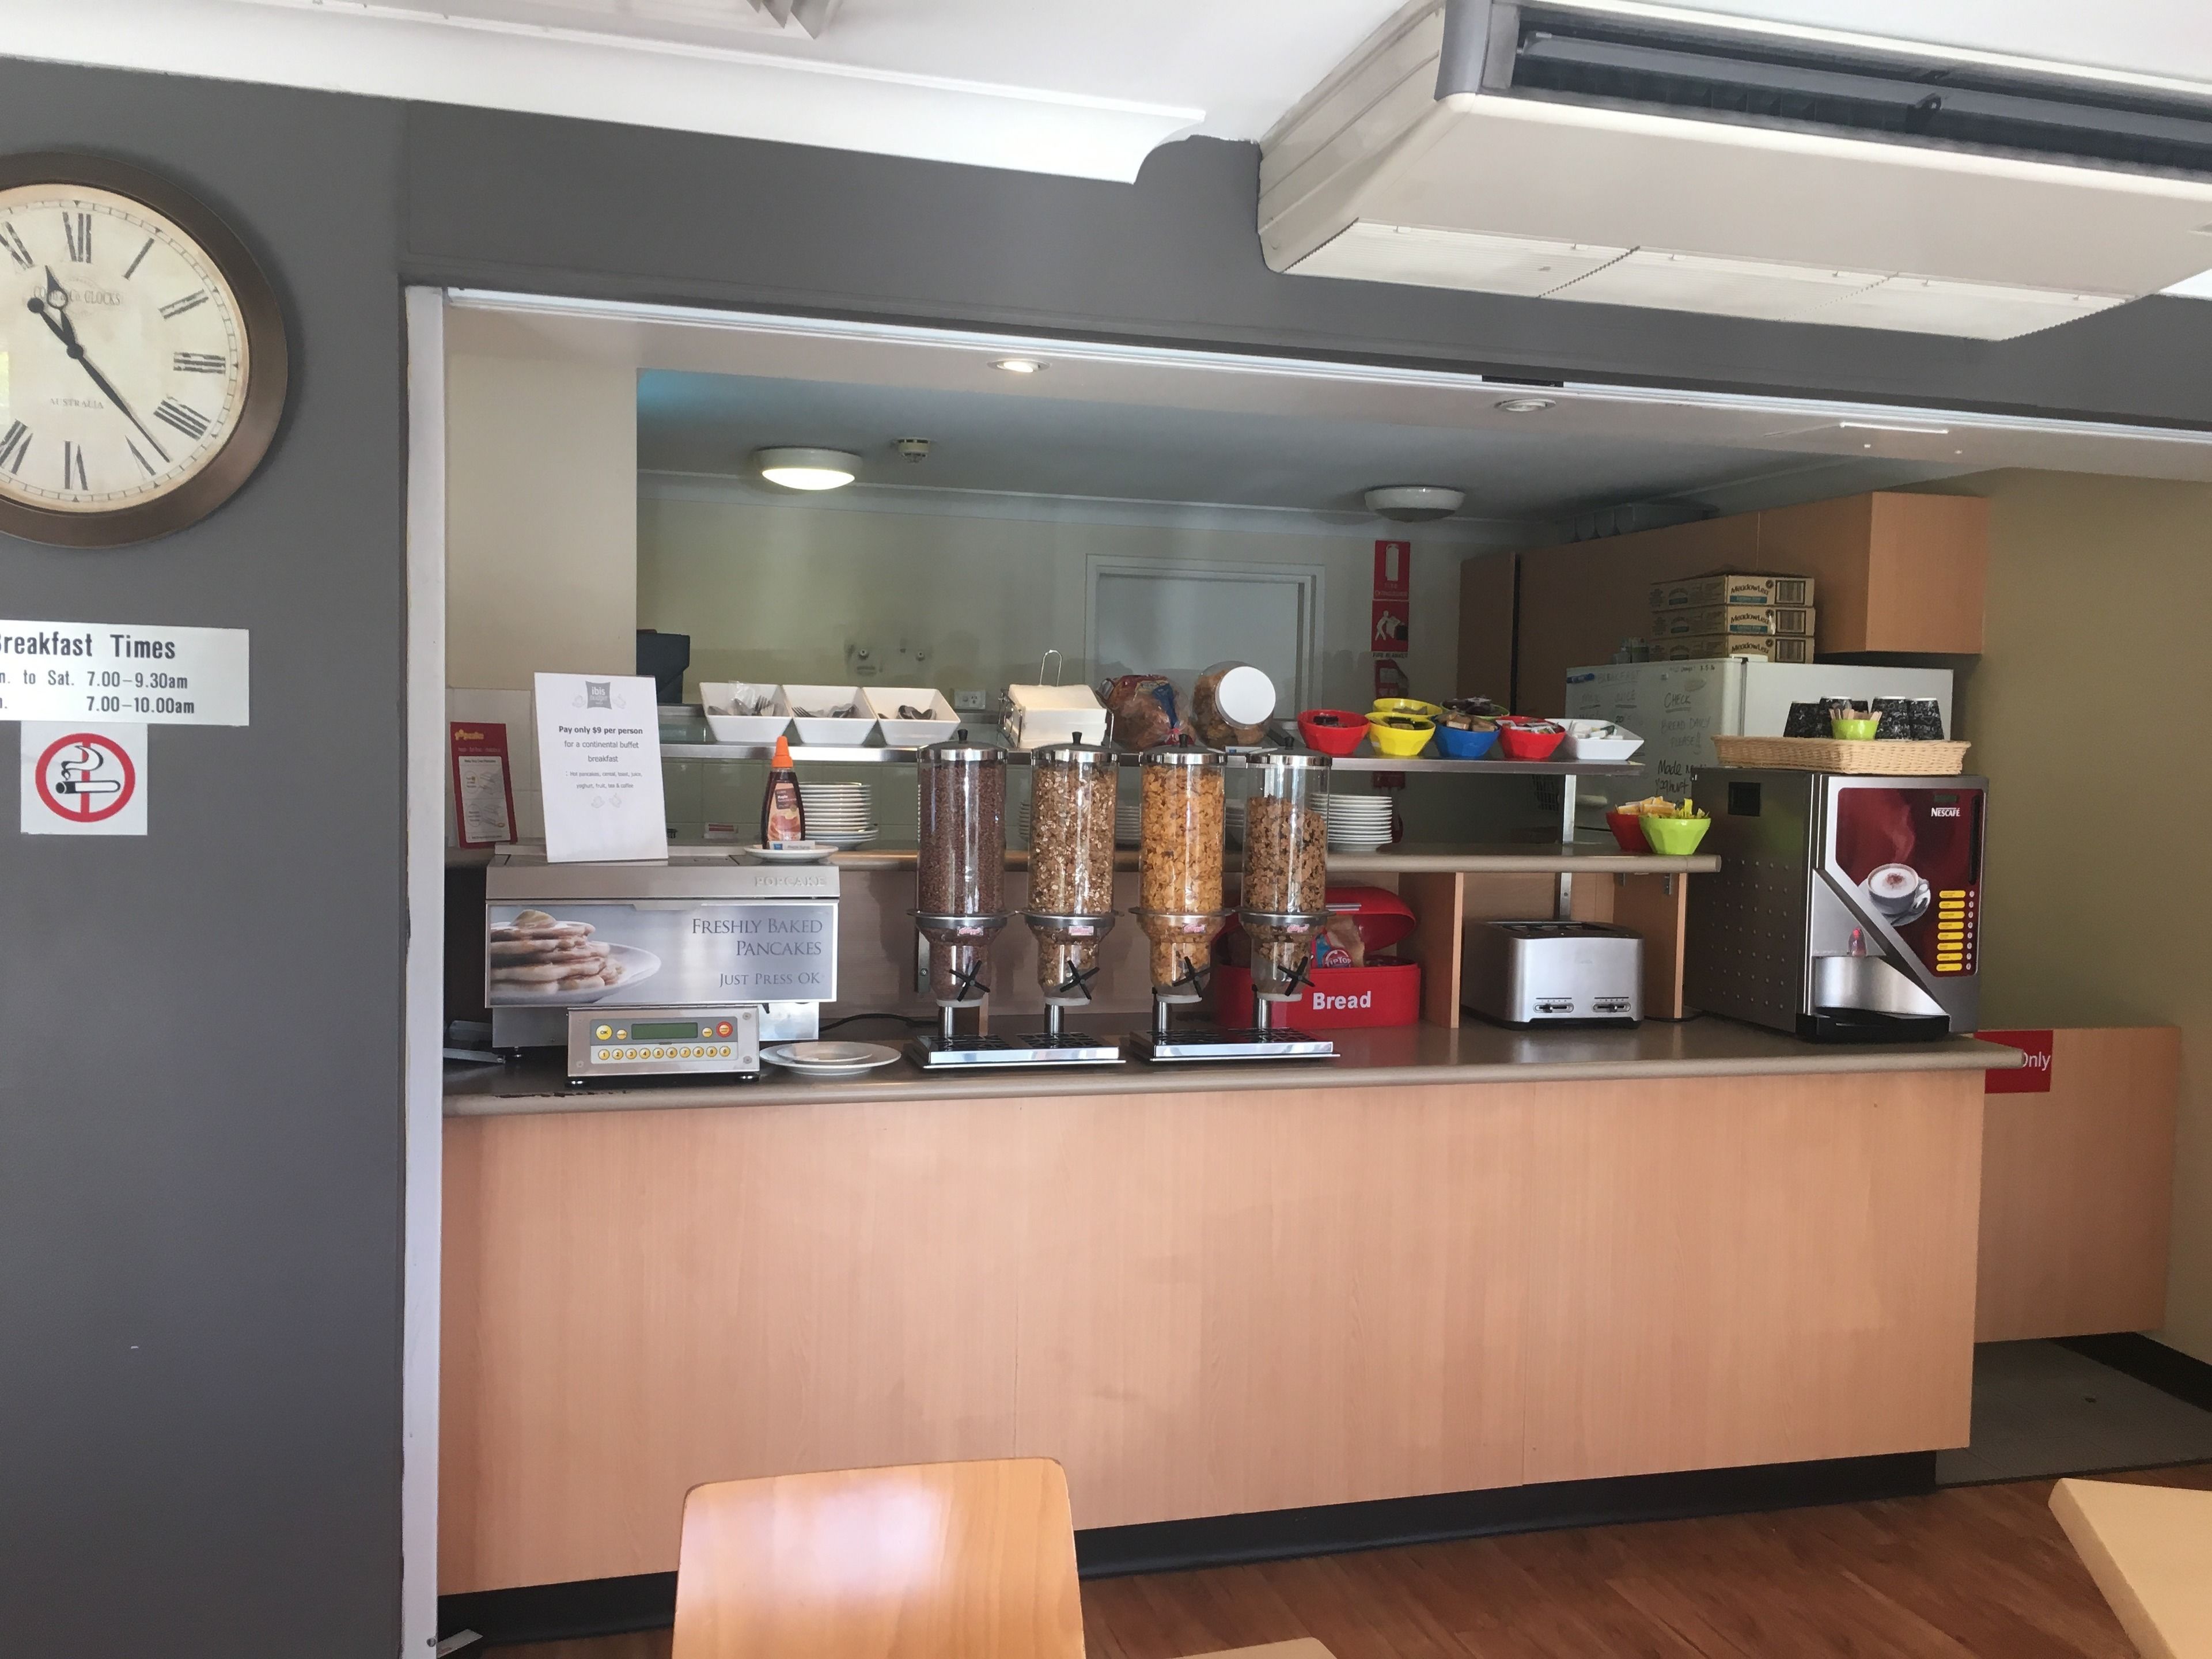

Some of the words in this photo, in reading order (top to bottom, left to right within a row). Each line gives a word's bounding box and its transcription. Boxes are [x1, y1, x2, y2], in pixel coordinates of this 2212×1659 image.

[84, 290, 121, 306] CLOCKS
[109, 634, 176, 659] Times
[24, 669, 36, 684] to
[48, 669, 75, 686] Sat.
[591, 686, 606, 696] ibis
[1664, 692, 1691, 709] CHECK
[558, 726, 573, 734] Pay
[574, 726, 590, 735] only
[1657, 760, 1682, 775] Made
[1931, 807, 1960, 817] NESCAFÉ
[753, 876, 827, 888] POPCAKE
[692, 918, 762, 934] FRESHLY
[768, 918, 823, 933] BAKED
[736, 940, 822, 956] PANCAKES
[719, 973, 749, 988] JUST
[755, 972, 793, 985] PRESS
[798, 972, 821, 984] OK
[1312, 991, 1372, 1010] Bread
